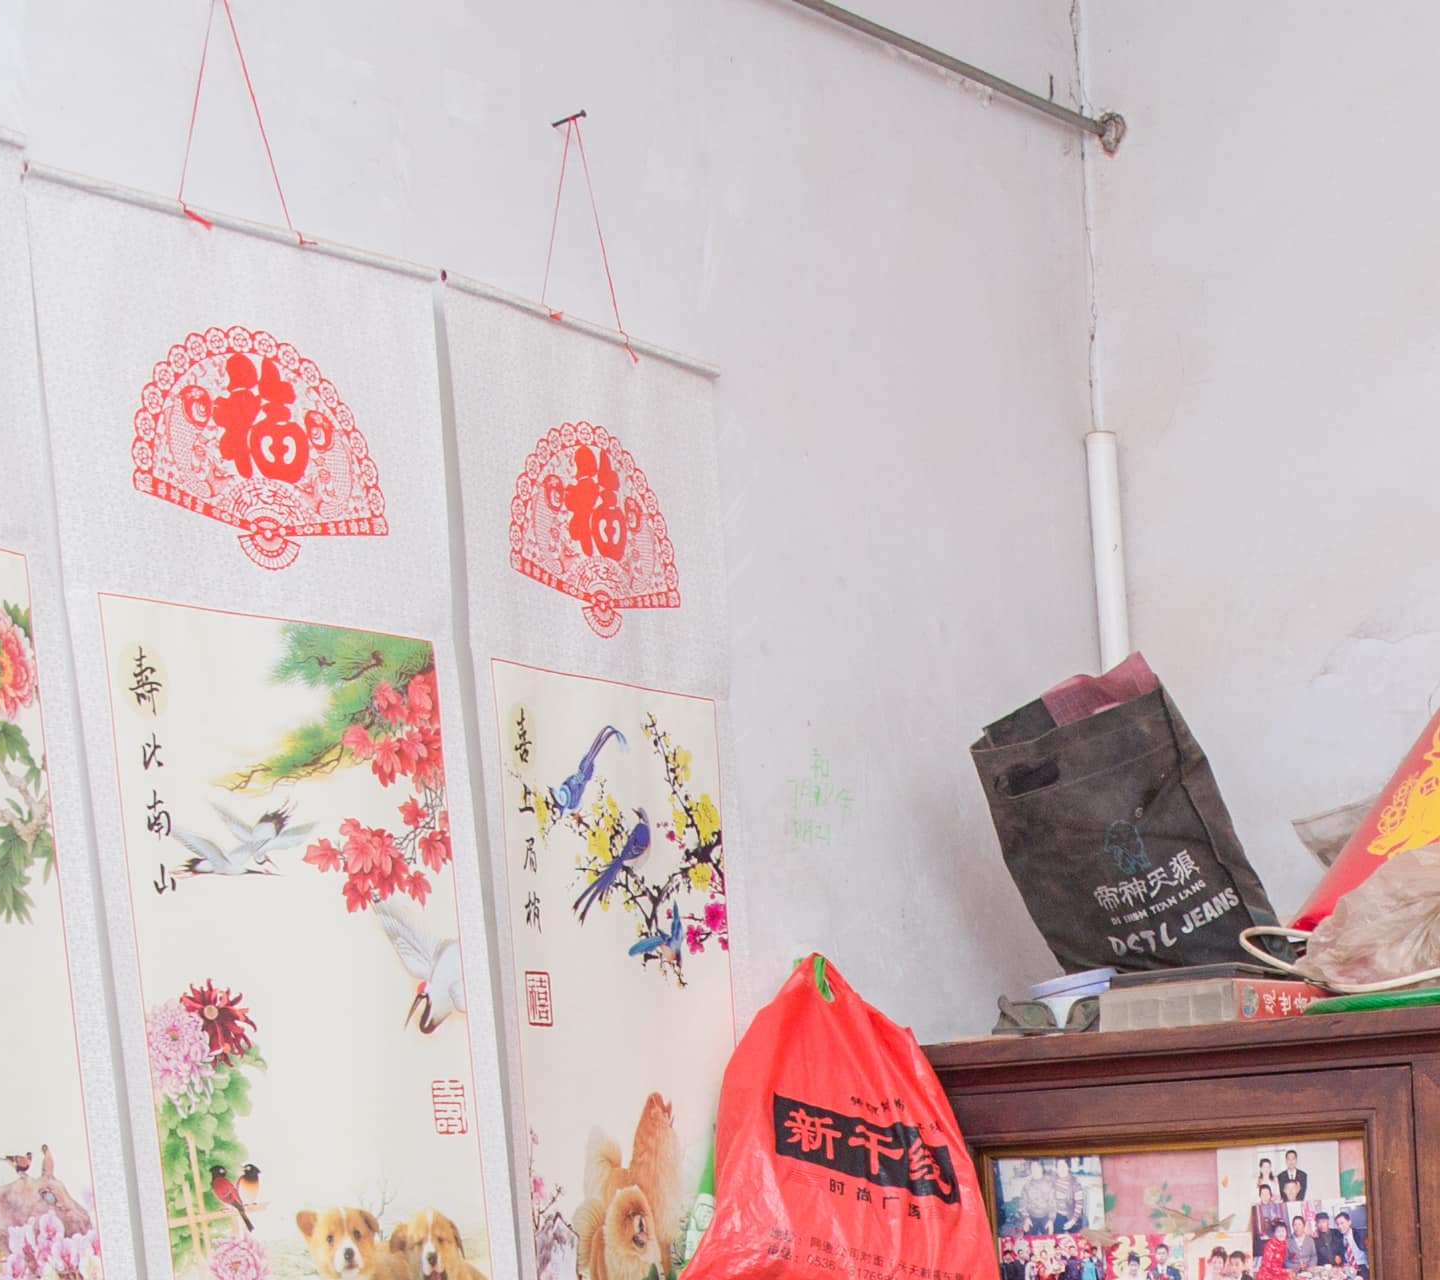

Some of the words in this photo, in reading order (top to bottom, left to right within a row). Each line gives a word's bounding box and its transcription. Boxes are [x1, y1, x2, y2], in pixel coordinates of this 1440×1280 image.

[211, 353, 310, 483] 福
[563, 446, 626, 560] 福
[1149, 895, 1178, 915] TIAN
[1177, 879, 1207, 900] LANG
[1180, 887, 1241, 934] JEANS
[829, 1178, 921, 1220] 时尚广场
